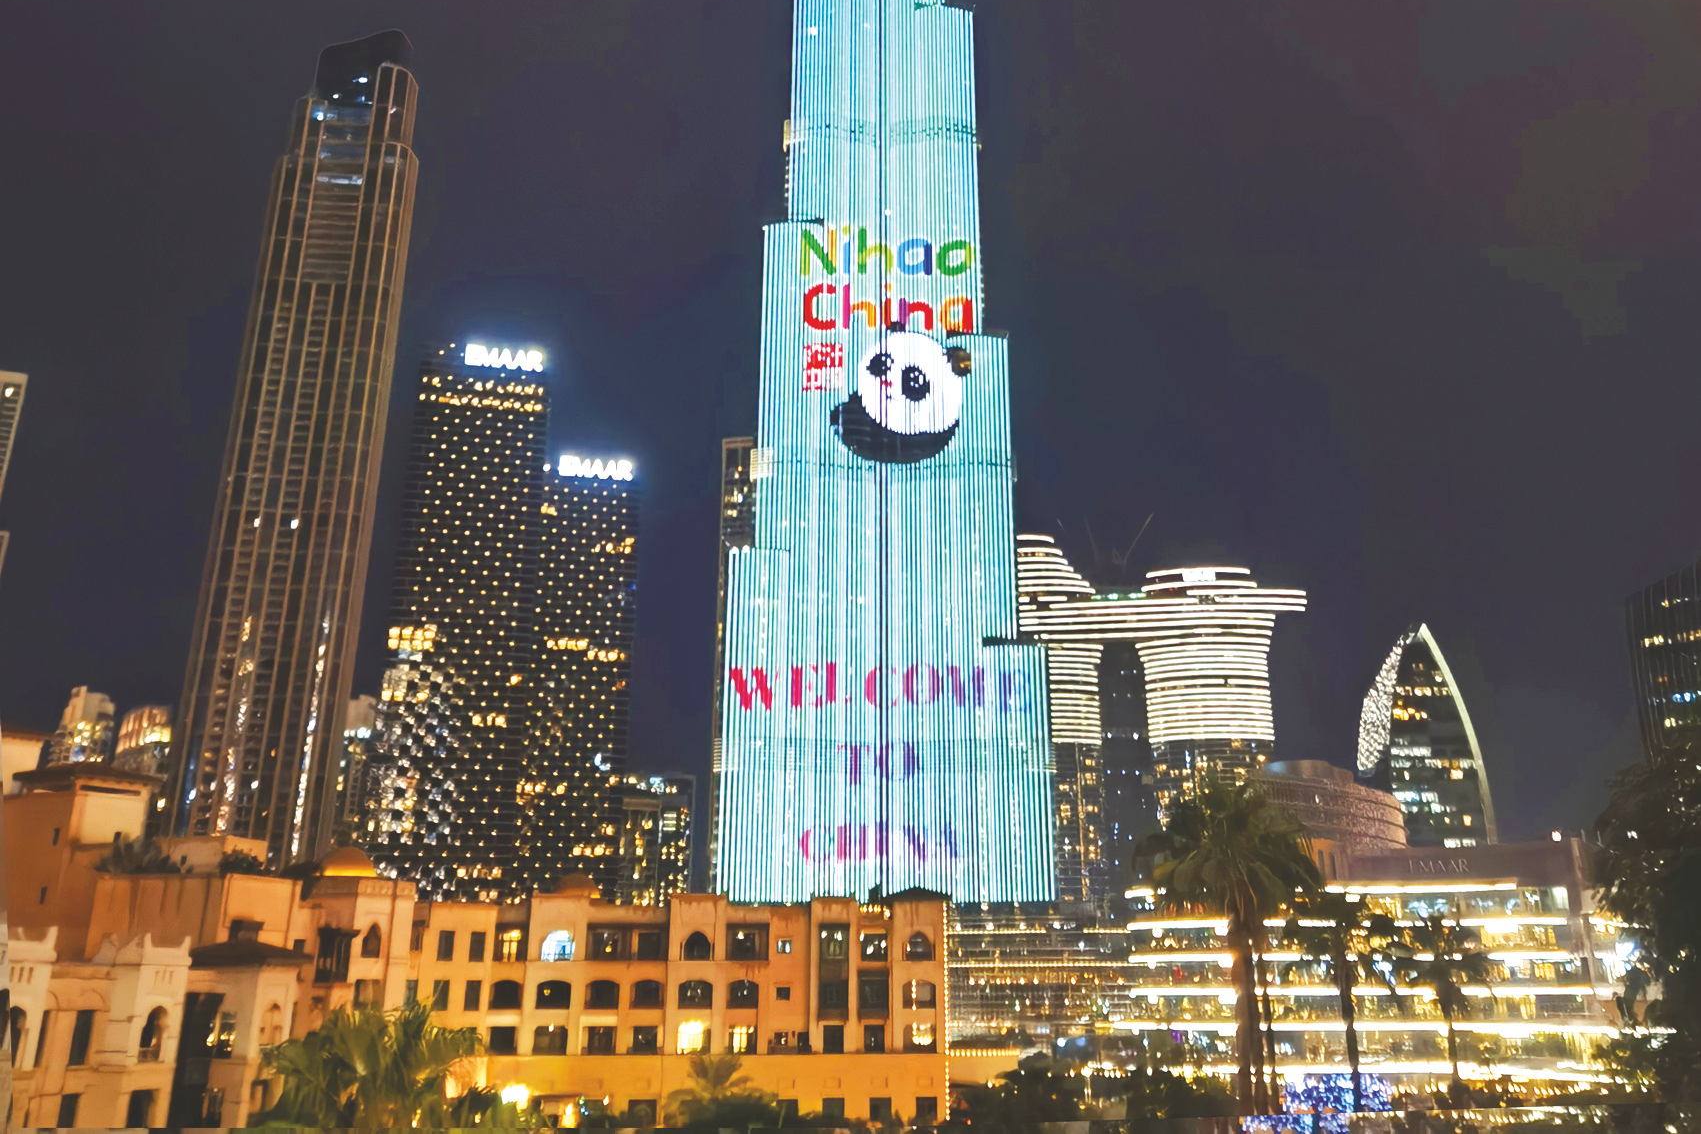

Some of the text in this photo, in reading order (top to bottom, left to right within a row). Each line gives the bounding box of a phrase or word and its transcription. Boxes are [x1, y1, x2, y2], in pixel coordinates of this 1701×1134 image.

[801, 225, 977, 277] Nihao
[804, 282, 973, 332] China
[465, 344, 543, 372] EMAAR
[558, 455, 633, 481] EMAAR
[730, 662, 1031, 713] WELCOME
